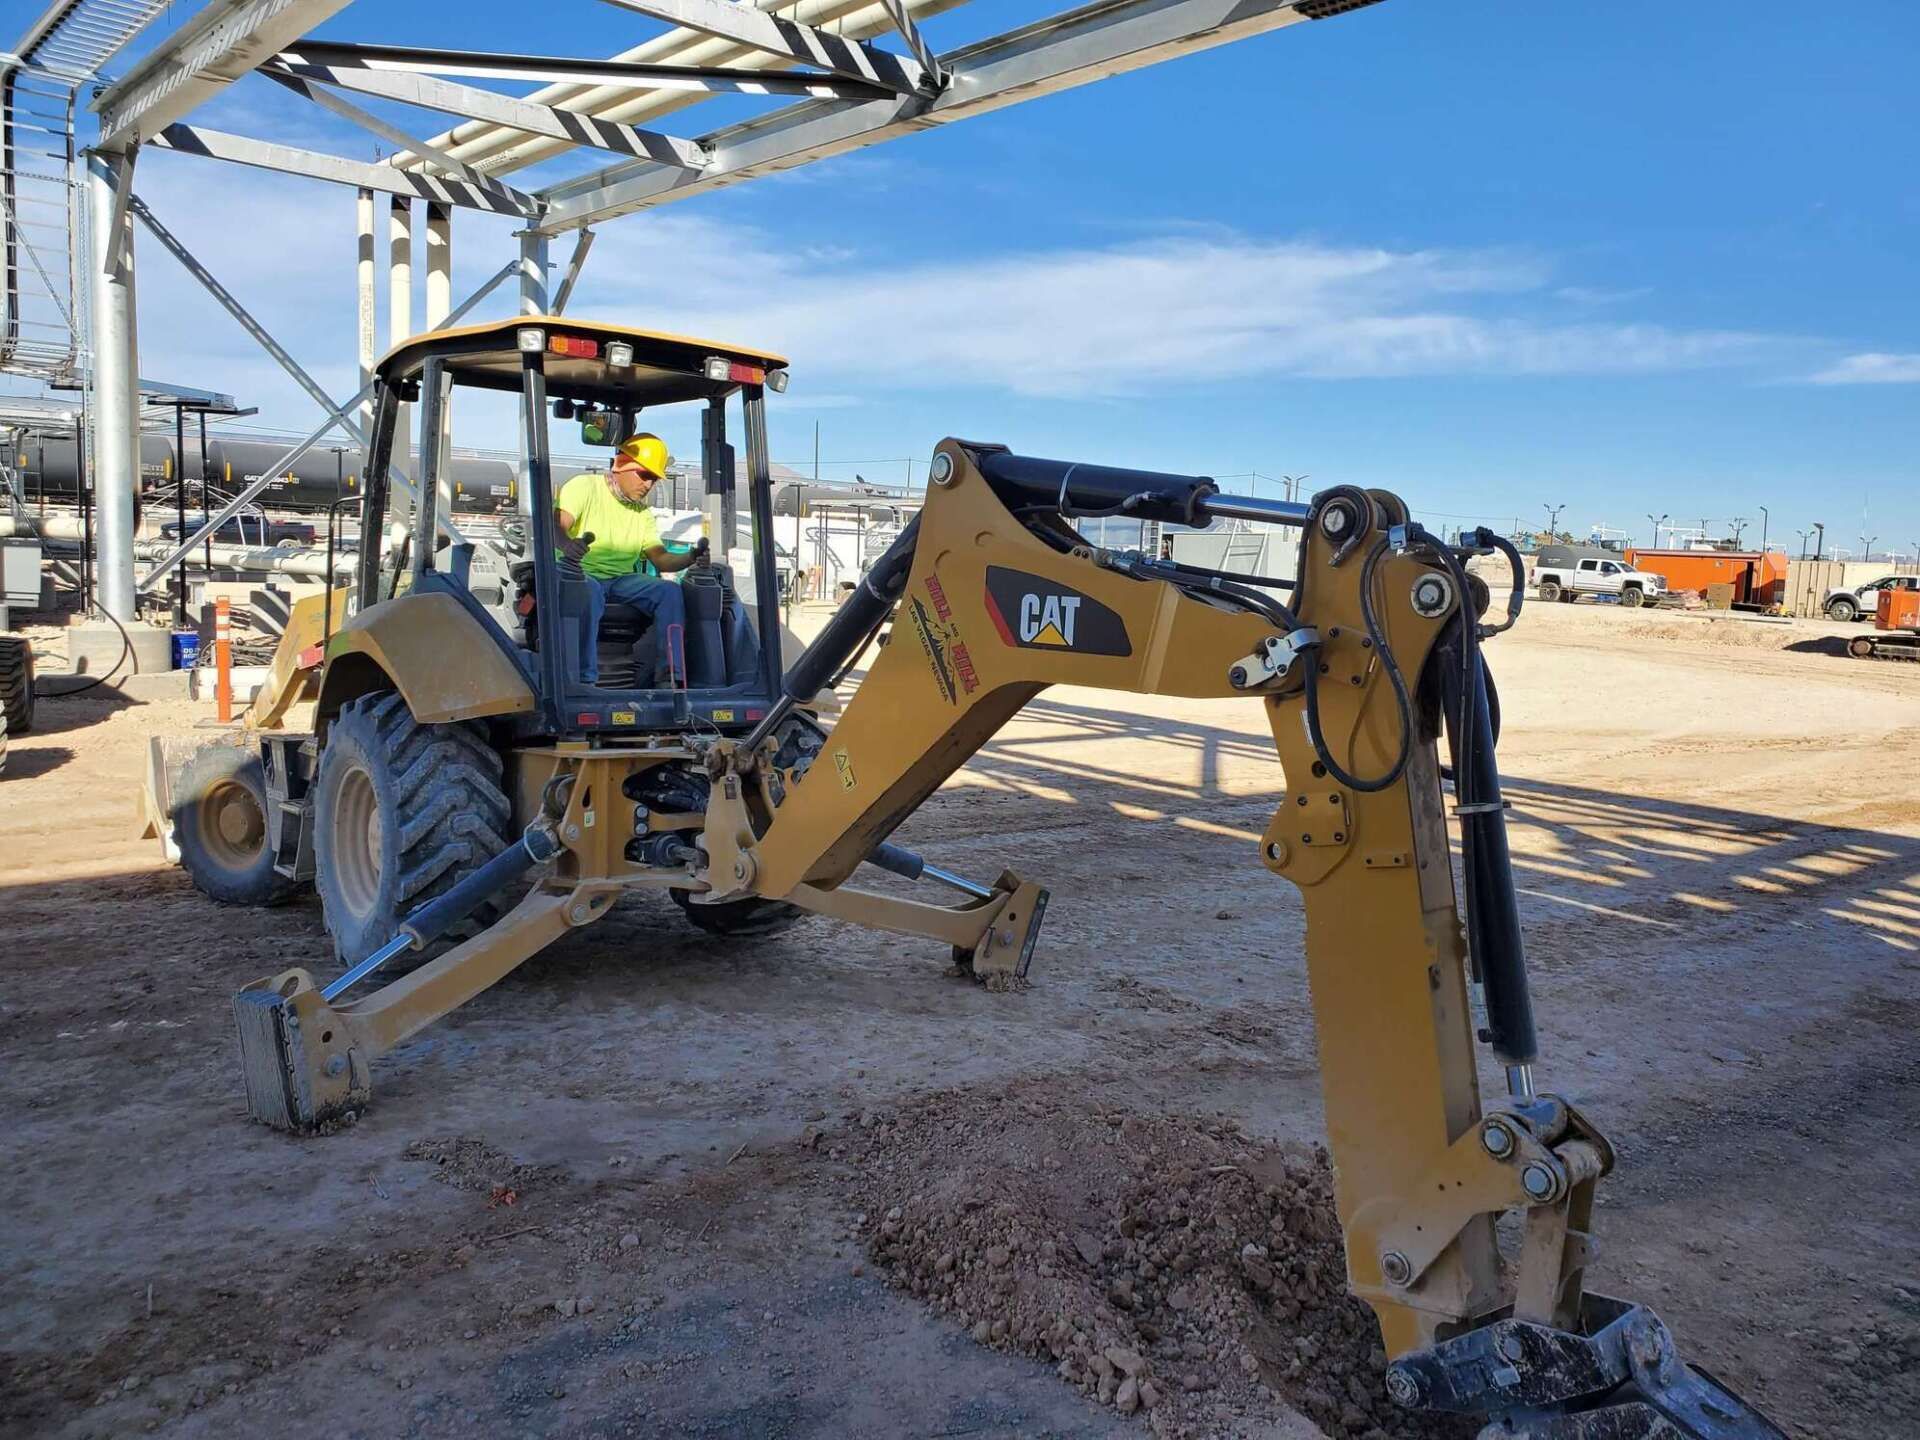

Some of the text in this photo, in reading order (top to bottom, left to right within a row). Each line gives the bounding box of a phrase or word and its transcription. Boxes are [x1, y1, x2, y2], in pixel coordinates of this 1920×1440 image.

[908, 604, 949, 702] LAS VEGAS NEVADA
[1019, 593, 1081, 647] CAT
